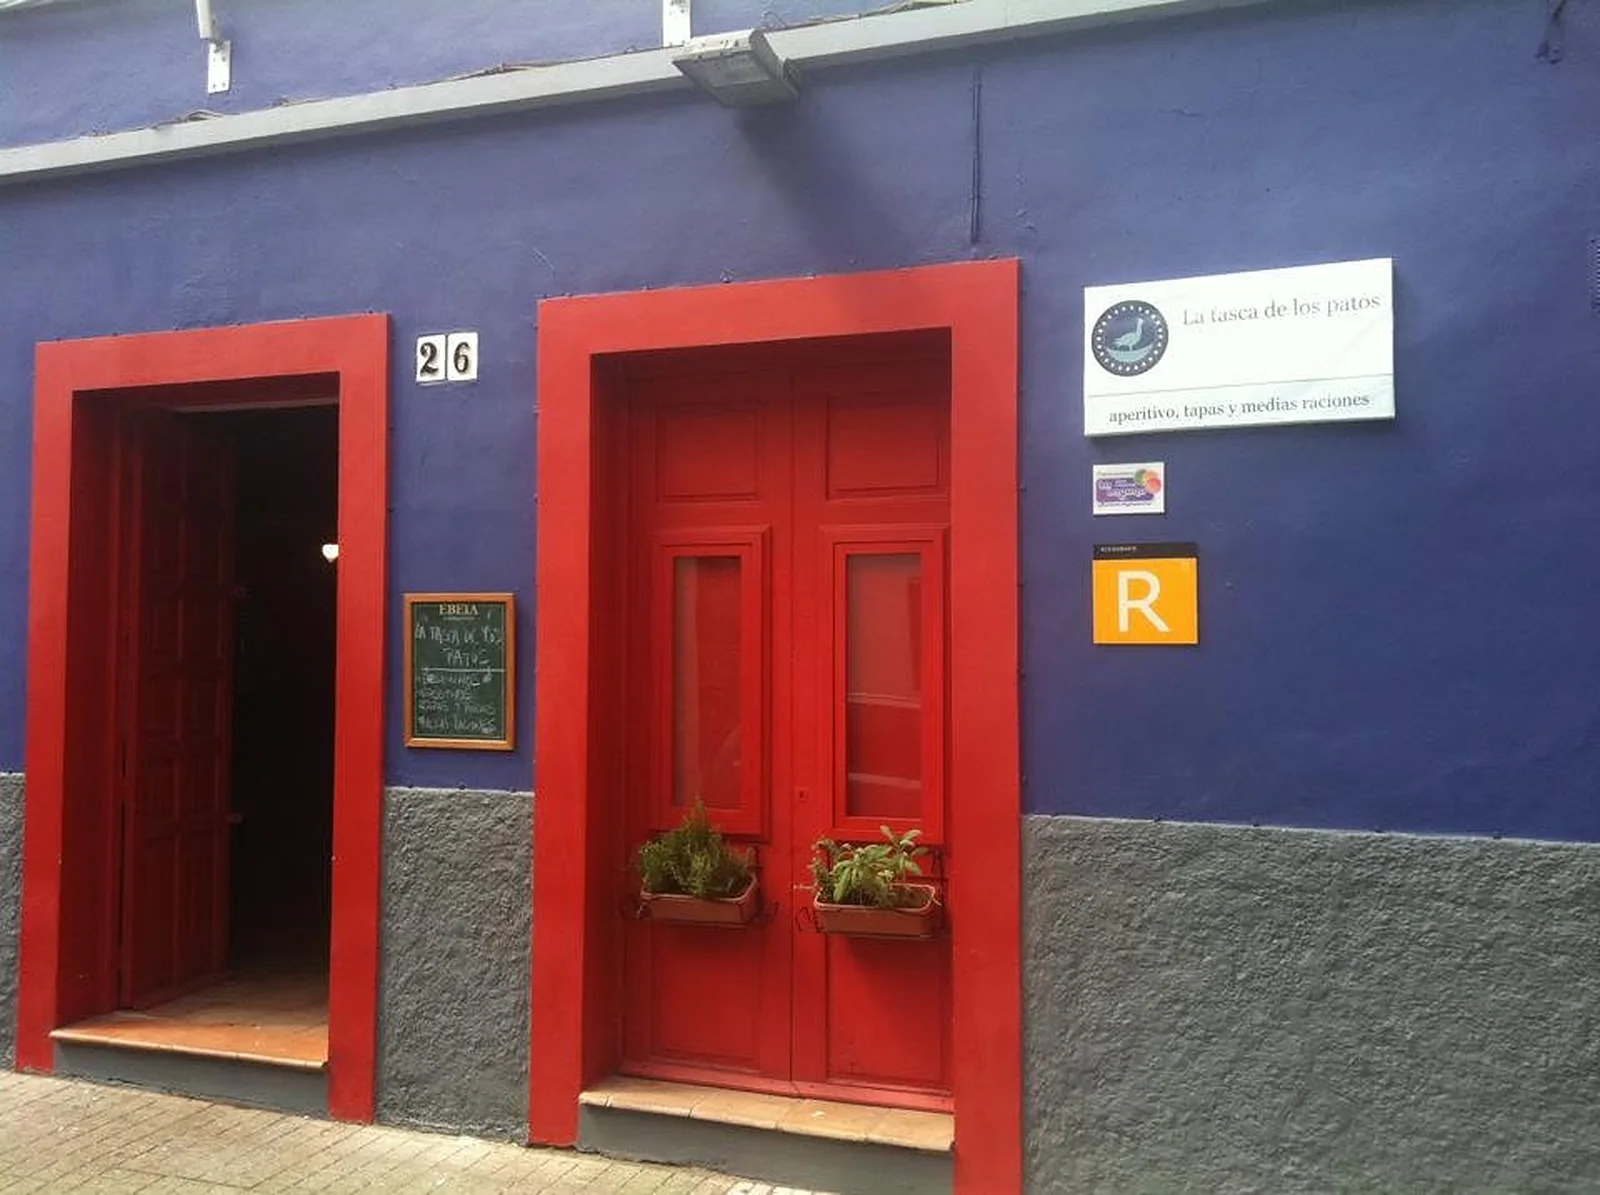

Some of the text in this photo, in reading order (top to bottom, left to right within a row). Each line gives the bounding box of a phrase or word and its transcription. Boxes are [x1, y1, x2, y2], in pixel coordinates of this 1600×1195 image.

[1183, 294, 1381, 326] La tasca de los patos
[420, 341, 471, 377] 26
[1109, 393, 1371, 425] aperitivo, tapas y medias raciones
[1118, 569, 1171, 633] R
